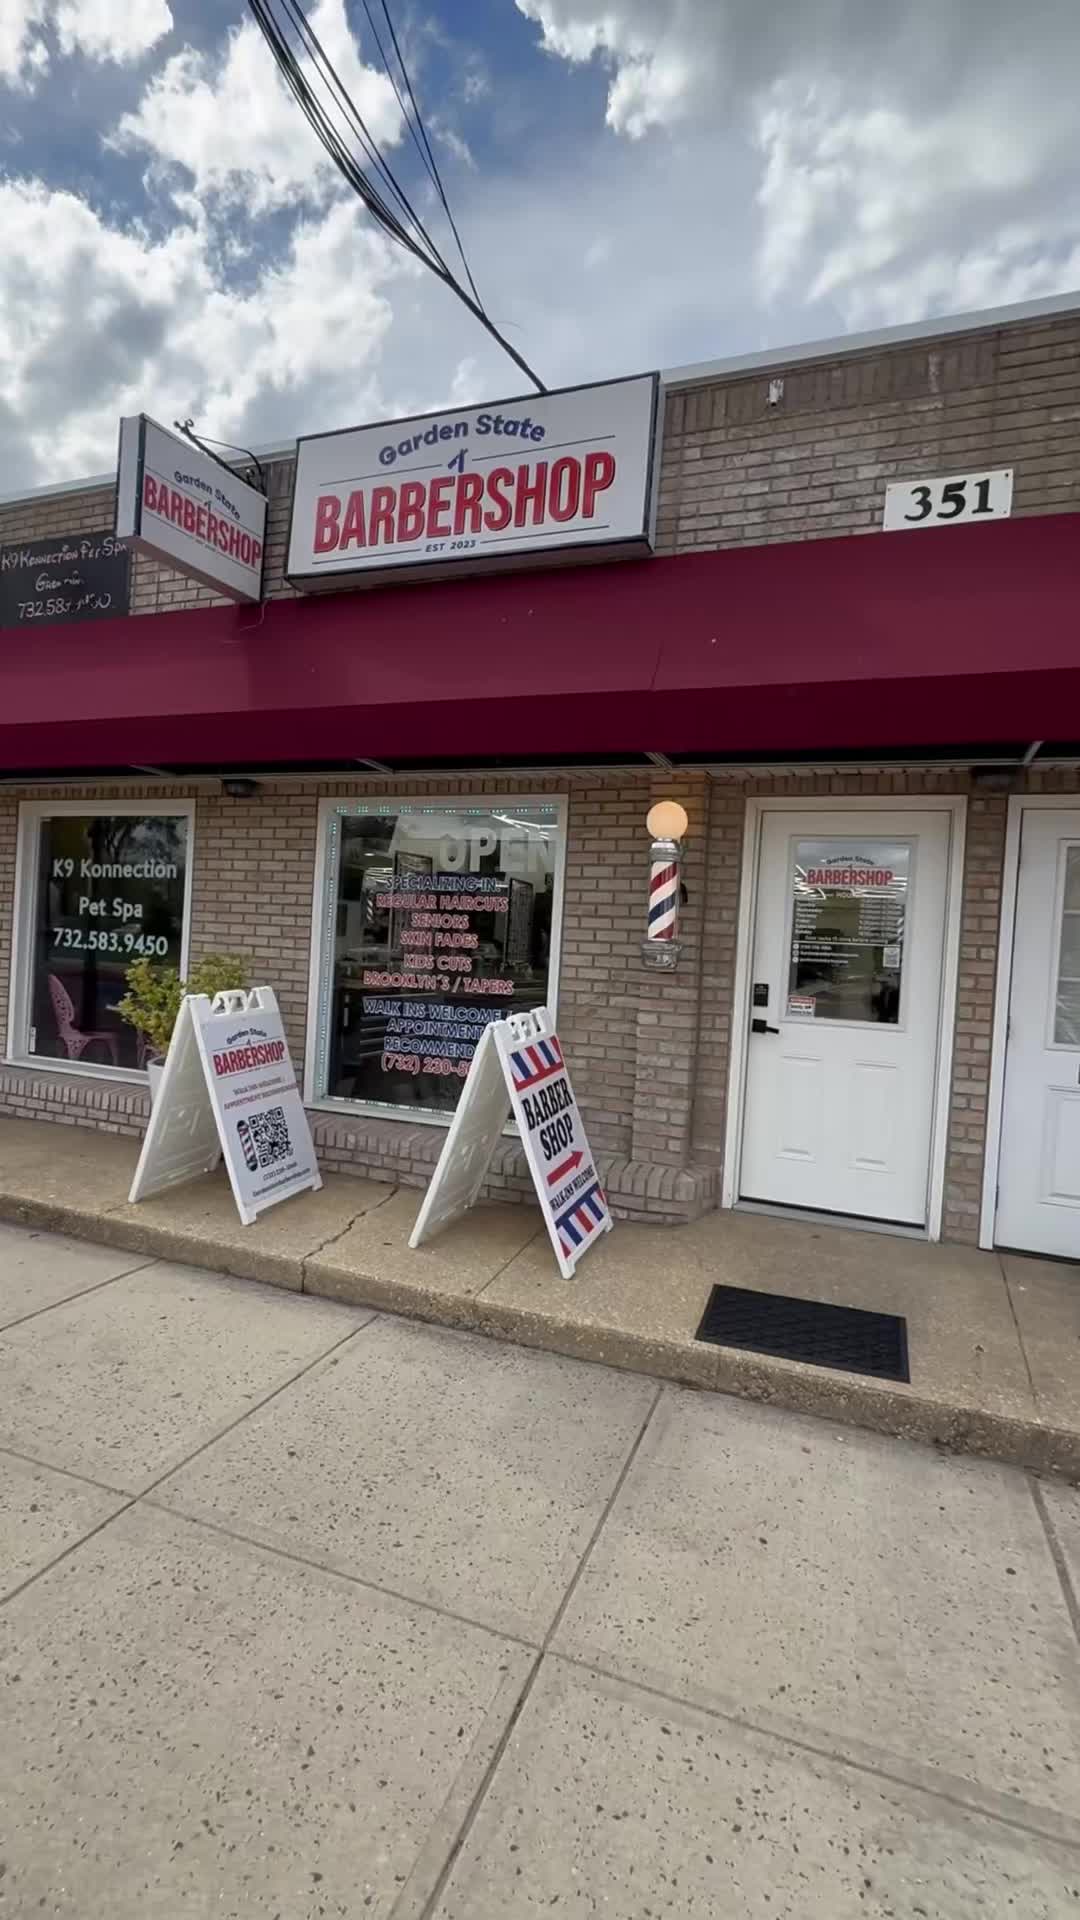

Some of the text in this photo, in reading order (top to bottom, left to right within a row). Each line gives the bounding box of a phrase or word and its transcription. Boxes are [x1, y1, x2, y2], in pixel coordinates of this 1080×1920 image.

[379, 414, 546, 466] Garden State
[174, 471, 241, 520] Garden State
[312, 451, 616, 554] BARBERSHOP
[904, 478, 994, 521] 351
[144, 473, 262, 568] BARBERSHOP
[425, 540, 476, 552] EST 2023
[440, 826, 556, 872] OPEN
[53, 859, 177, 879] K9 Konnection
[807, 869, 893, 886] BARBERSHOP
[386, 875, 477, 892] SPECIALIZING
[79, 897, 143, 922] Pet Spa
[376, 894, 509, 912] REGULAR HAIRCUTS
[411, 914, 469, 929] SENIORS
[53, 928, 168, 955] 732.583.9450
[400, 932, 479, 949] SKIN FADES
[403, 954, 472, 972] KIDS CUTS
[463, 978, 514, 995] TAPERS
[362, 1000, 400, 1016] WALK
[403, 1003, 426, 1018] INS
[429, 1005, 502, 1023] WELCOME
[213, 1040, 285, 1076] BARBERSHOP
[381, 1052, 420, 1075] (732)
[521, 1078, 573, 1131] BARBER
[540, 1113, 574, 1161] SHOP
